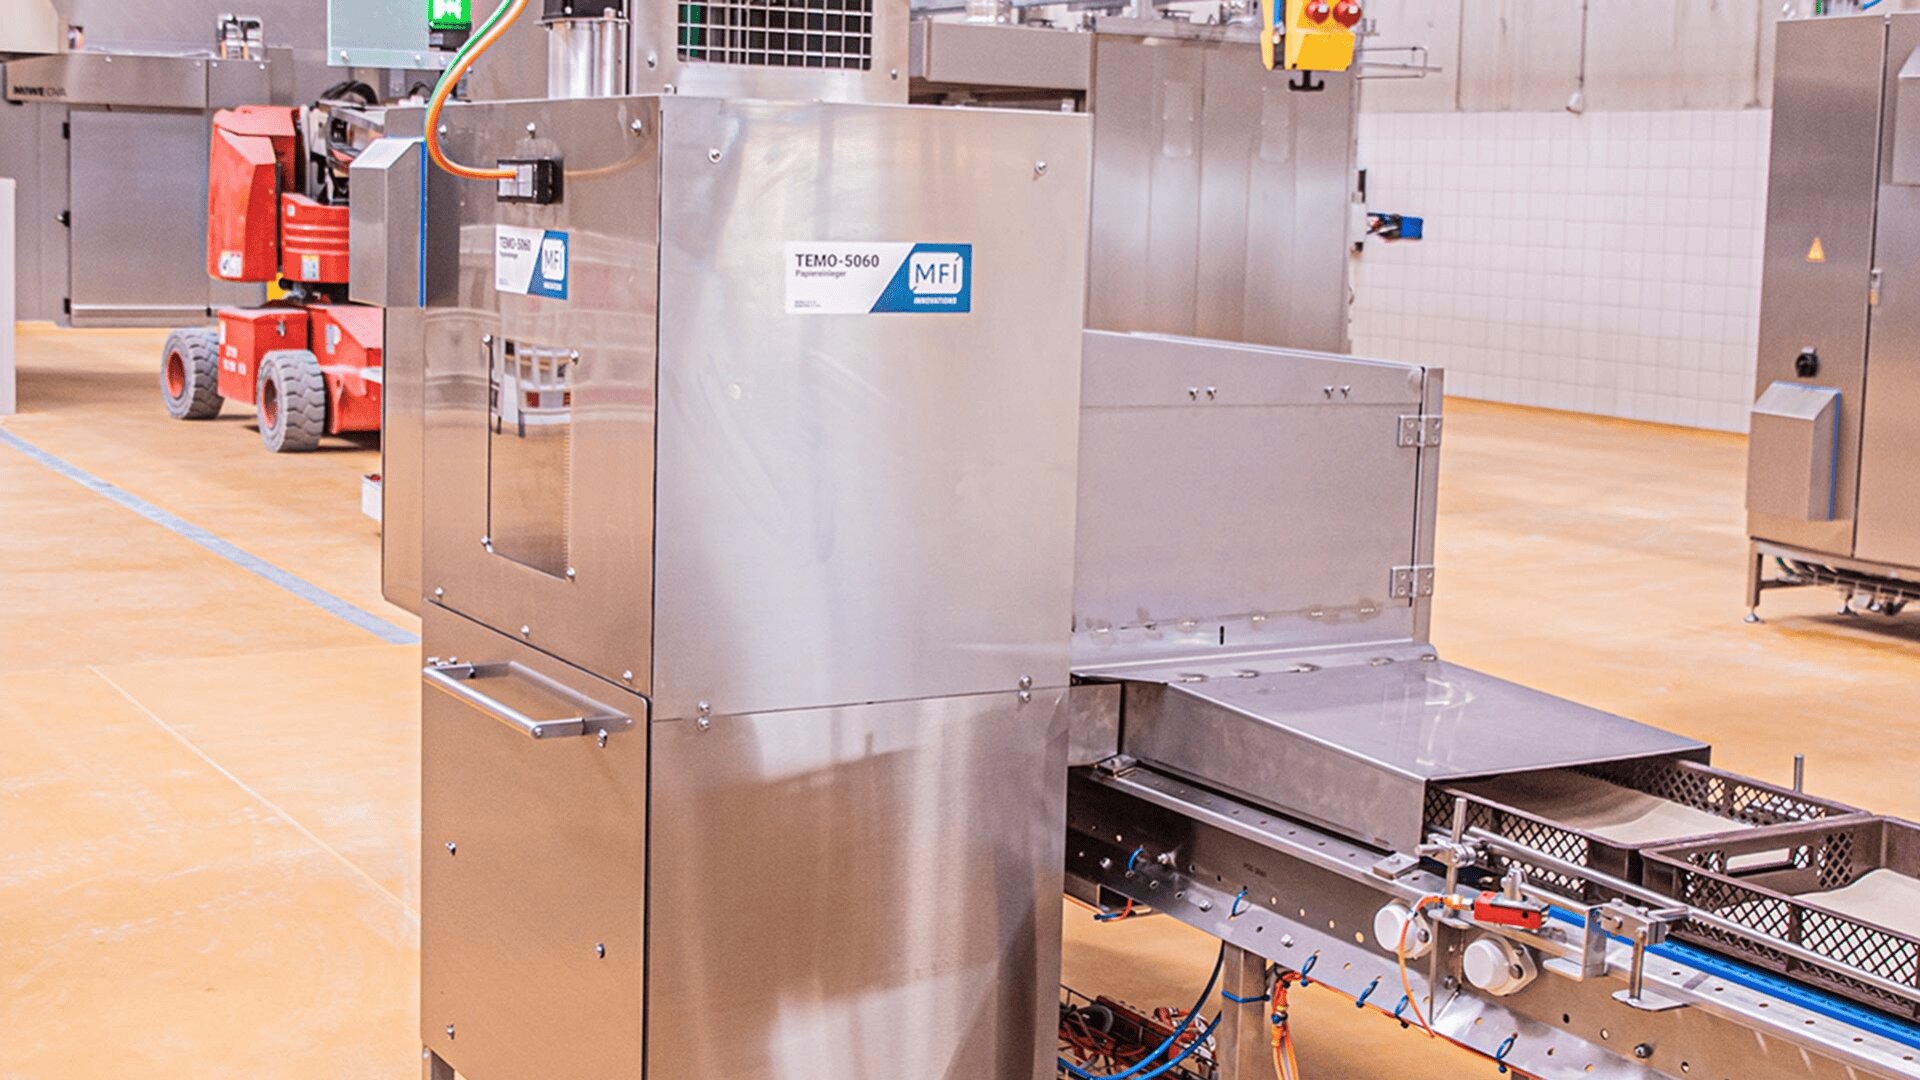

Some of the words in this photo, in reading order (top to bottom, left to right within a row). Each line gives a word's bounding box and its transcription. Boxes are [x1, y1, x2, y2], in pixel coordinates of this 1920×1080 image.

[795, 254, 880, 268] TEMO-5060
[795, 270, 847, 278] Papiereinleger
[915, 263, 958, 284] MFI
